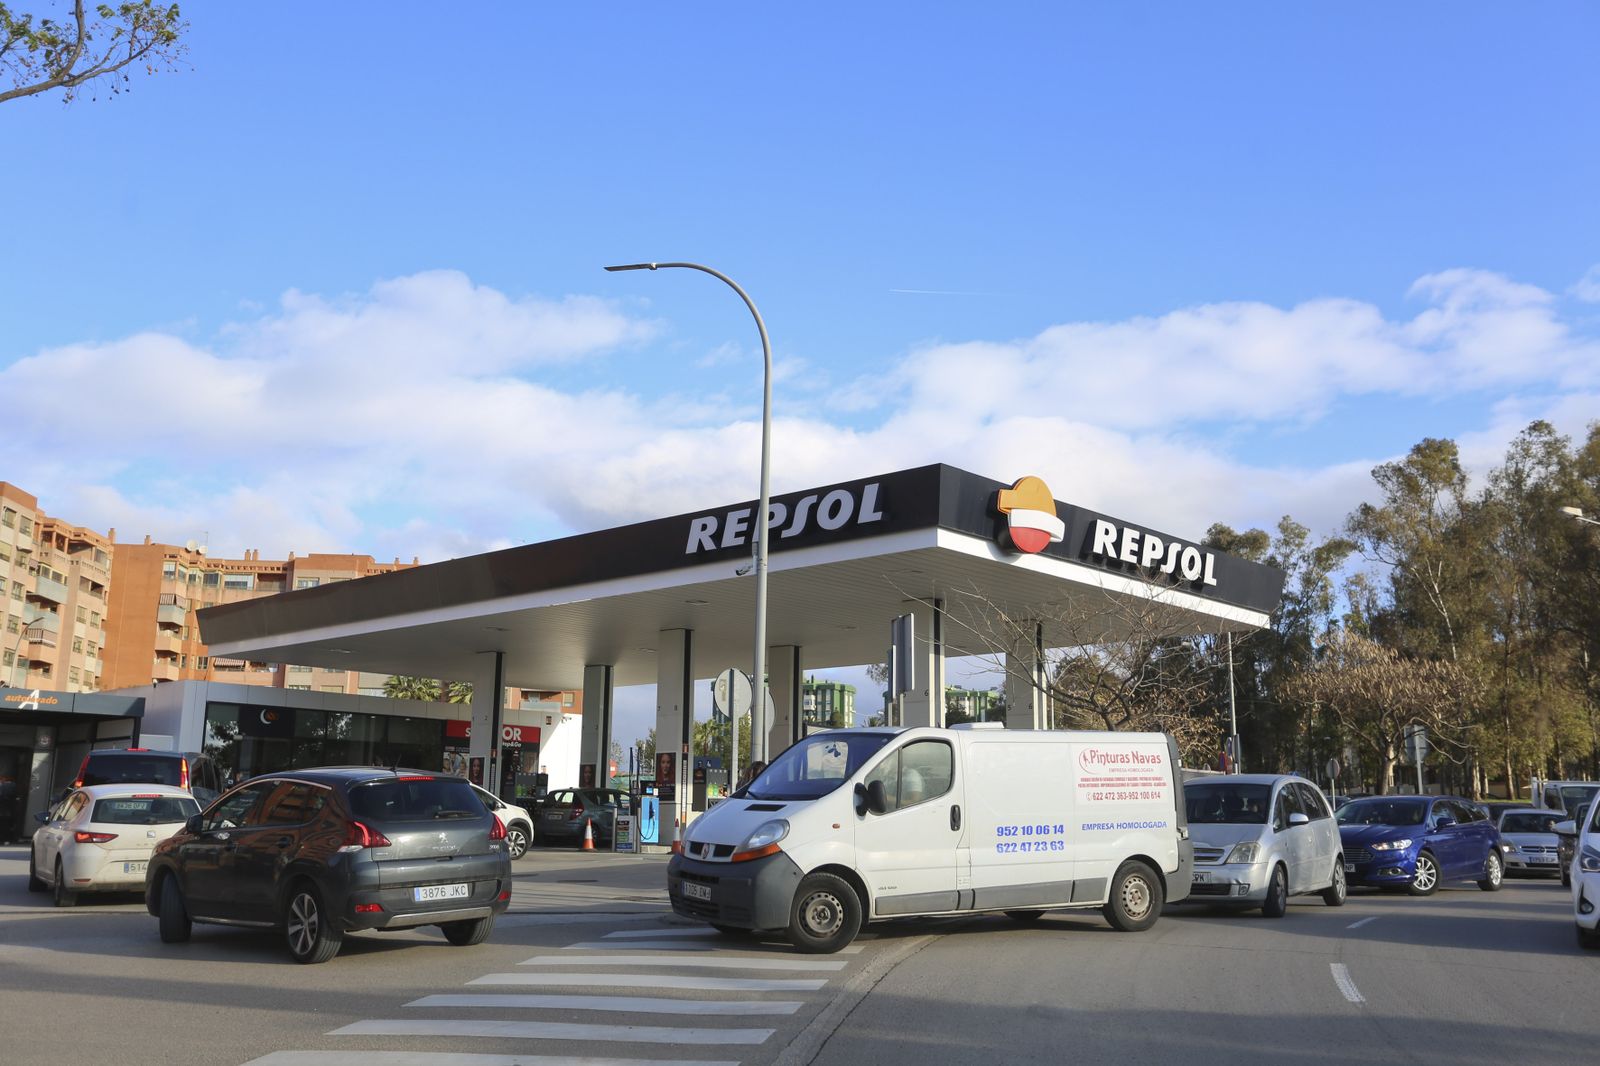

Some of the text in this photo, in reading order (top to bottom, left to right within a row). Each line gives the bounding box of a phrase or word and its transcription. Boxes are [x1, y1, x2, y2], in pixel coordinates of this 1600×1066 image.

[686, 483, 882, 555] REPSOL
[1093, 519, 1217, 586] REPSOL
[1090, 750, 1162, 765] Pinturas Navas
[1093, 792, 1103, 800] 622
[1105, 792, 1115, 800] 472
[1151, 792, 1161, 800] 614
[997, 825, 1064, 836] 952 10 06 14
[1082, 821, 1167, 831] EMPRESA HOMOLOGADA
[996, 840, 1064, 853] 622 47 23 63
[422, 885, 466, 898] 3876 JKC
